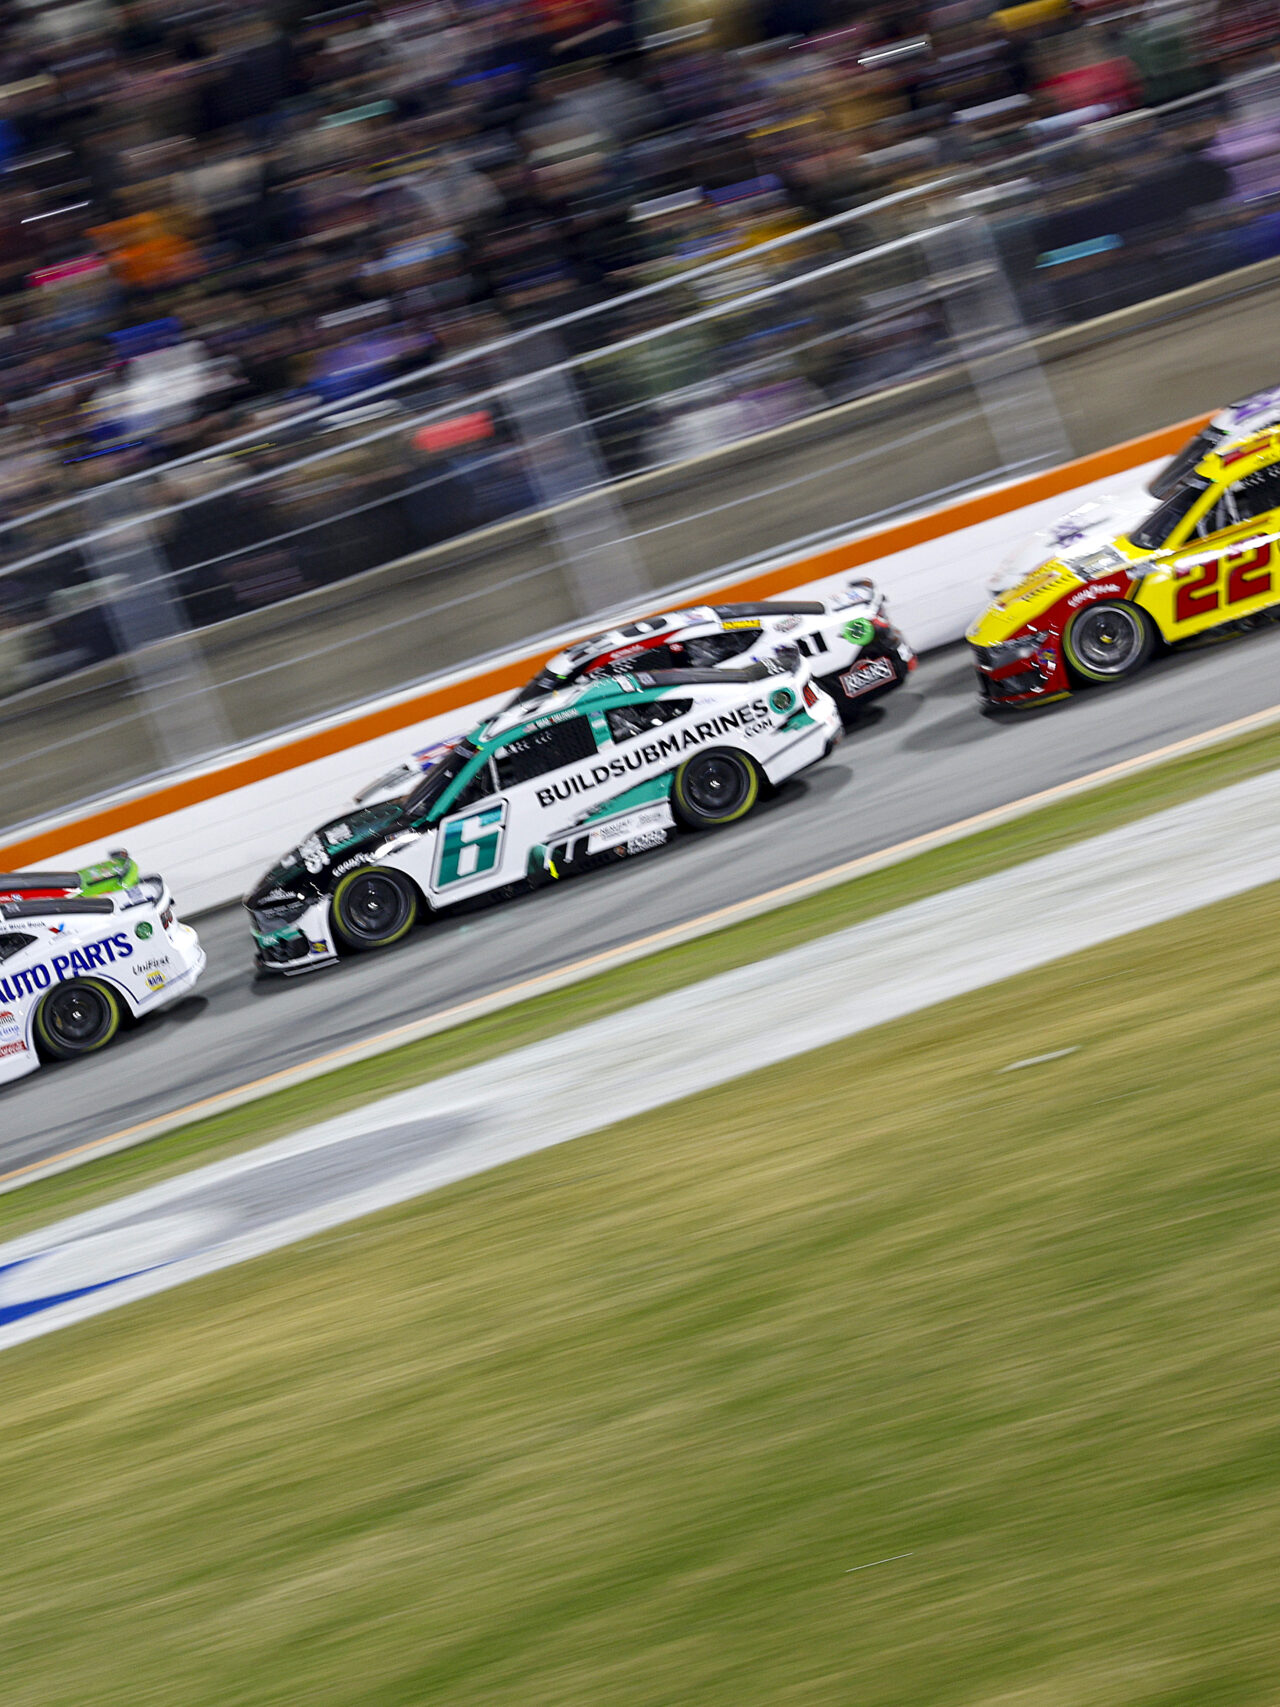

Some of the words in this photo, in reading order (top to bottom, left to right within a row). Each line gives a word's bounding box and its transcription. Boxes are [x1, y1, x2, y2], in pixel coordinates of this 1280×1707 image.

[1175, 532, 1271, 624] 22
[535, 699, 769, 808] BUILDSUBMARINES
[433, 800, 506, 890] 6
[51, 932, 134, 984] PARTS
